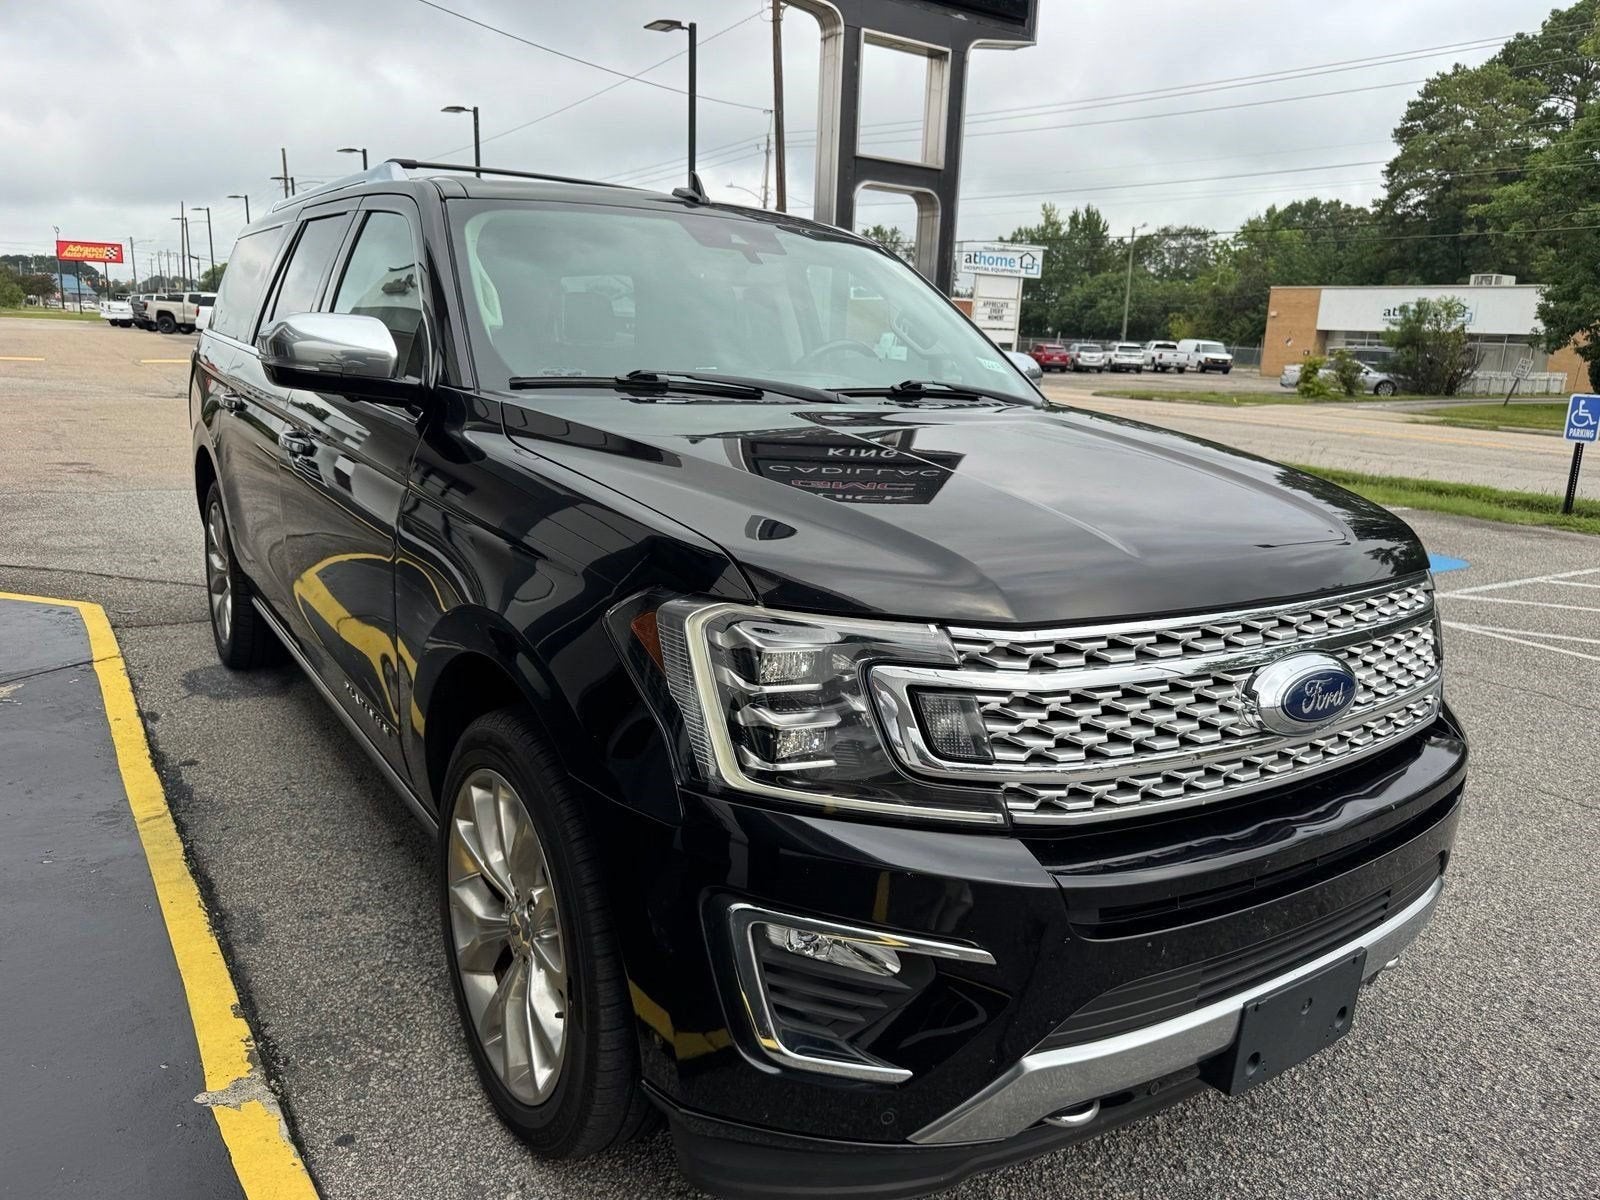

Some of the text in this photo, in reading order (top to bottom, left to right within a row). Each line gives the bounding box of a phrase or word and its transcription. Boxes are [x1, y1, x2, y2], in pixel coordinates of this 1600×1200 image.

[66, 244, 104, 252] Advance
[964, 250, 1016, 268] athome
[991, 266, 1021, 274] EQUIPMENT
[983, 301, 1009, 309] APPRECIATE
[1569, 427, 1595, 438] PARKING
[1302, 677, 1345, 713] Ford
